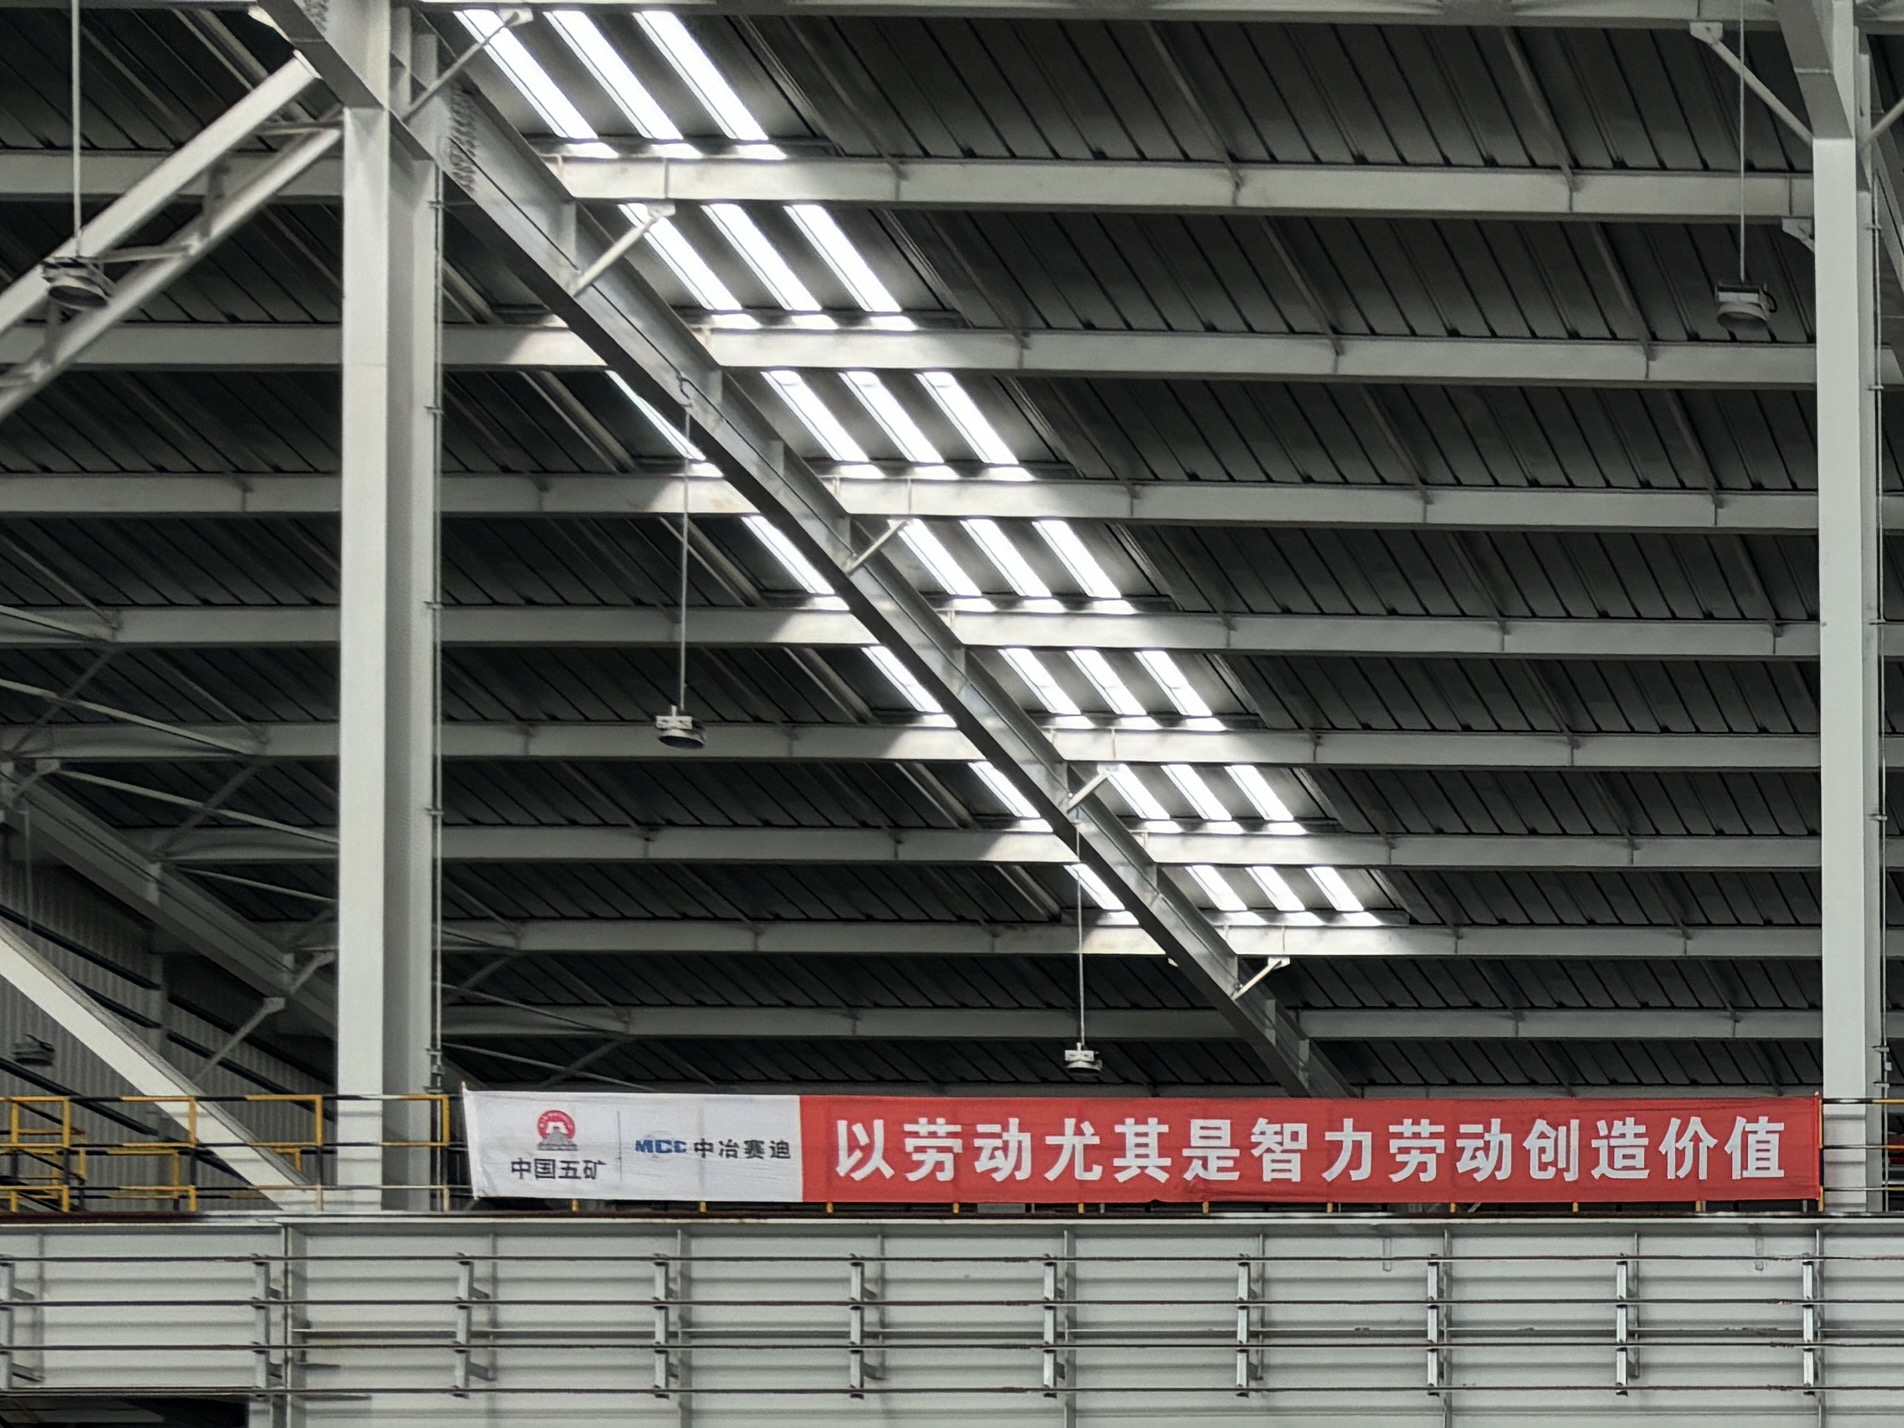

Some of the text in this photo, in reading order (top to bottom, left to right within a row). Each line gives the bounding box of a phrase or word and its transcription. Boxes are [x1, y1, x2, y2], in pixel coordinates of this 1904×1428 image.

[634, 1138, 792, 1160] MCC 中冶赛迪
[836, 1116, 1786, 1183] 以劳动尤其是智力劳动创造价值
[510, 1157, 607, 1180] 中国五矿
